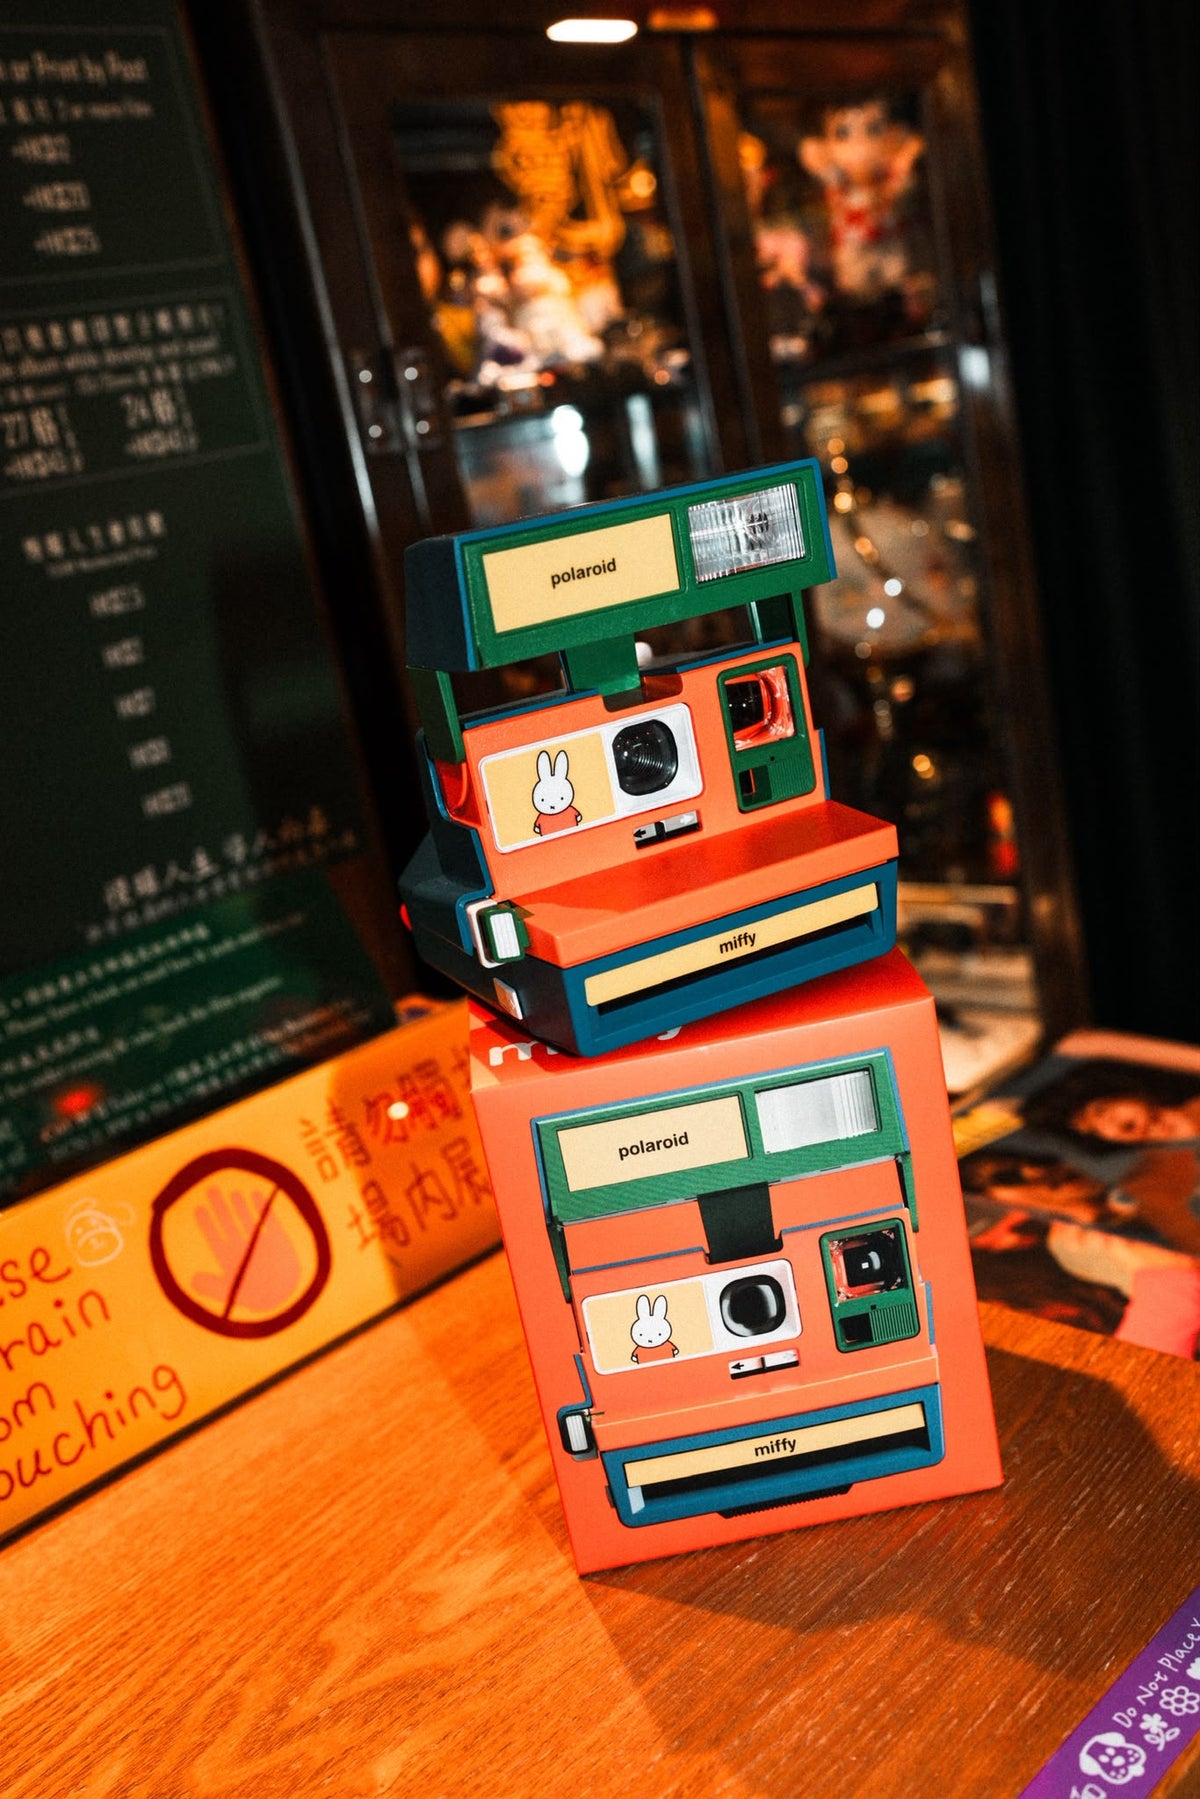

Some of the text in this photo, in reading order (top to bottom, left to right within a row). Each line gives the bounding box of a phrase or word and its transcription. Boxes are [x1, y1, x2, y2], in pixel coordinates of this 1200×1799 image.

[550, 557, 617, 590] polaroid
[719, 932, 756, 954] miffy
[618, 1131, 689, 1161] polaroid
[754, 1437, 797, 1457] miffy
[1112, 1706, 1138, 1729] Do
[1136, 1671, 1169, 1706] Not
[1157, 1632, 1200, 1673] Place
